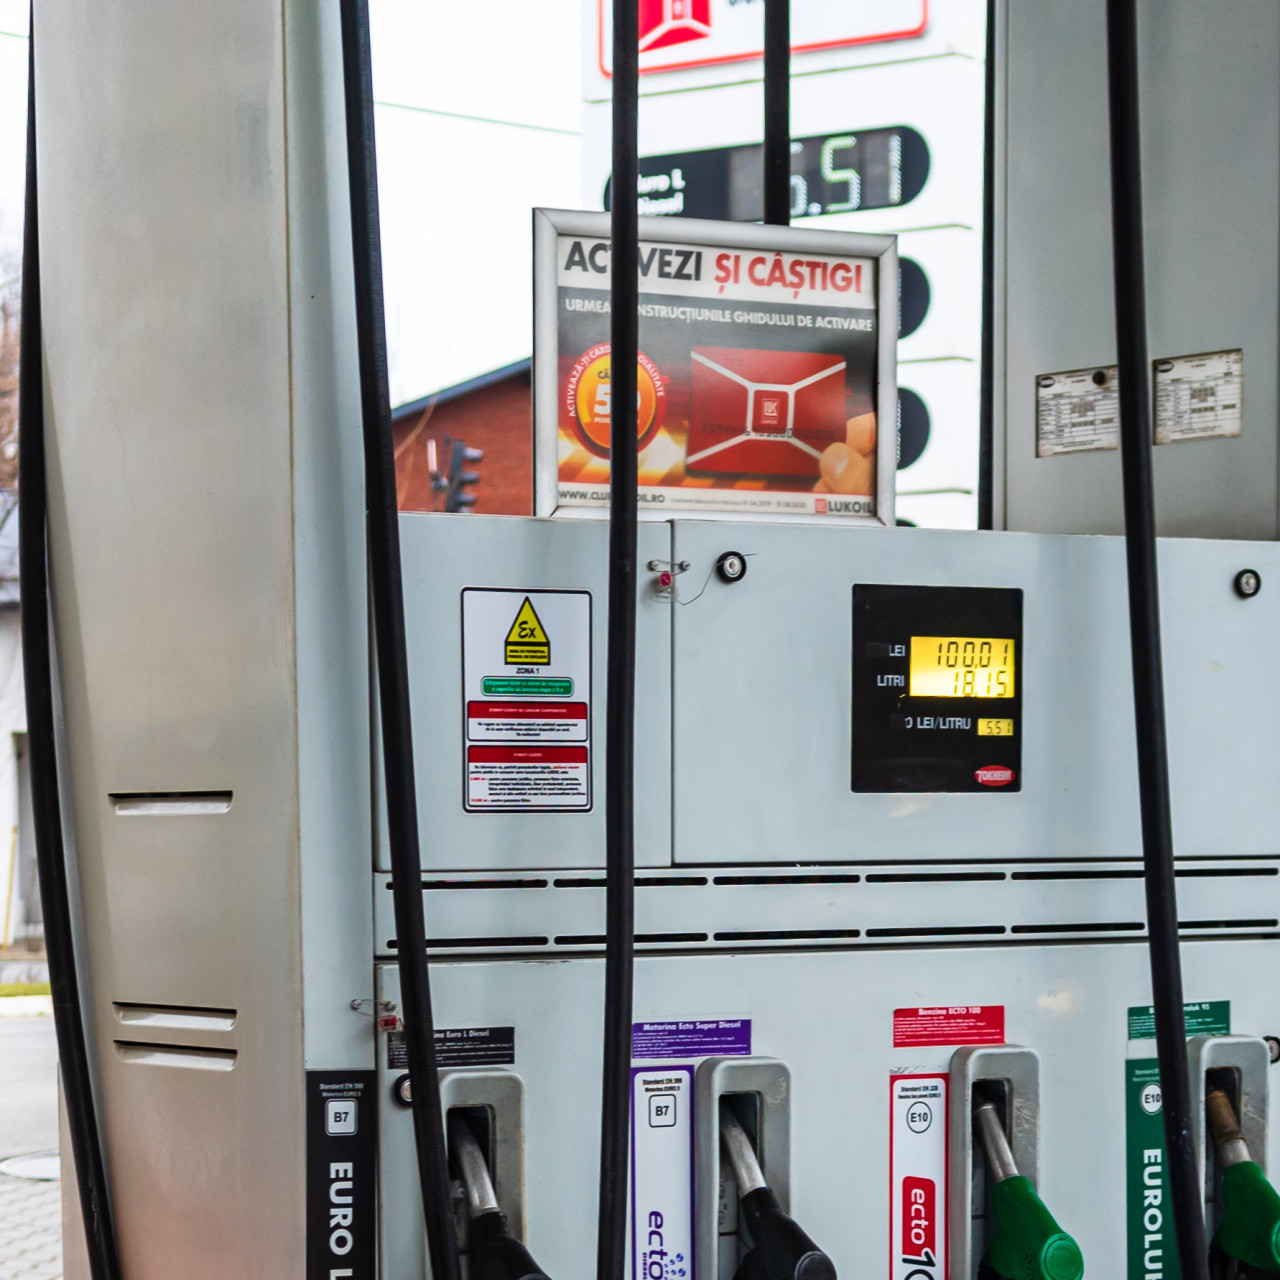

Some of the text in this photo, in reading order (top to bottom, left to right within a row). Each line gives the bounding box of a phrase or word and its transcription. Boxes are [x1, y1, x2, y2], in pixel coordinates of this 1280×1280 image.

[564, 240, 702, 281] ACVEZI
[714, 252, 741, 295] ȘI
[566, 297, 611, 314] URMEA
[638, 302, 732, 323] NSTRUCȚIUNILE
[797, 314, 814, 328] DE
[815, 315, 873, 331] ACTIVARE
[637, 355, 665, 397] OIALITATE
[558, 489, 665, 503] WWW.CLUOIL.RO
[828, 500, 873, 514] LUKOIL
[518, 620, 536, 639] Ex
[888, 644, 905, 657] LEI
[876, 674, 905, 687] LITRI
[917, 716, 971, 730] LEI/LITRU
[948, 1007, 967, 1015] ECTO
[642, 1020, 742, 1031] Motorina Ecto Super Diesel
[469, 1029, 490, 1037] Diesel
[1144, 1093, 1162, 1104] E10
[333, 1111, 350, 1123] B7
[655, 1105, 670, 1117] B7
[910, 1112, 928, 1123] E10
[329, 1162, 354, 1256] EURO
[910, 1187, 929, 1245] ecto
[648, 1210, 668, 1280] ecto
